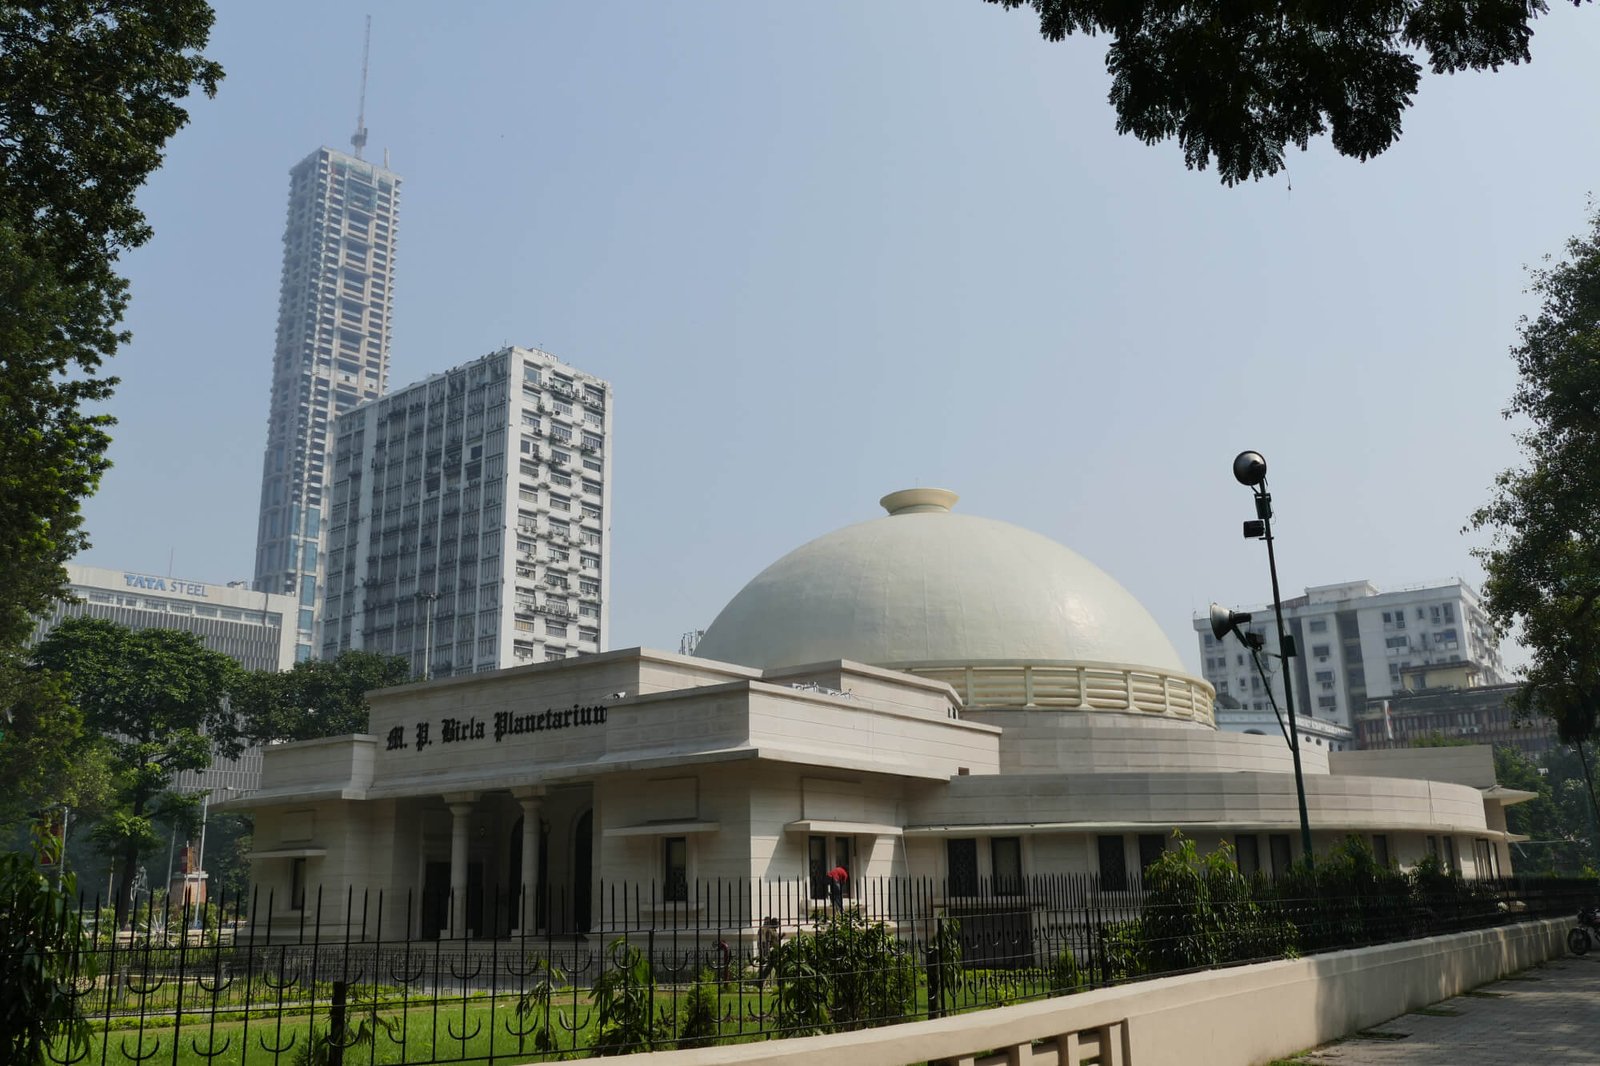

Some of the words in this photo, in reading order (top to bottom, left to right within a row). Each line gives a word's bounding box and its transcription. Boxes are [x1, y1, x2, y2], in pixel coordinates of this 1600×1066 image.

[124, 574, 167, 592] TATA
[170, 582, 209, 598] STEEL
[387, 726, 408, 750] M.
[416, 722, 432, 751] P.
[441, 716, 485, 743] Birla
[494, 704, 608, 742] Planetarium
